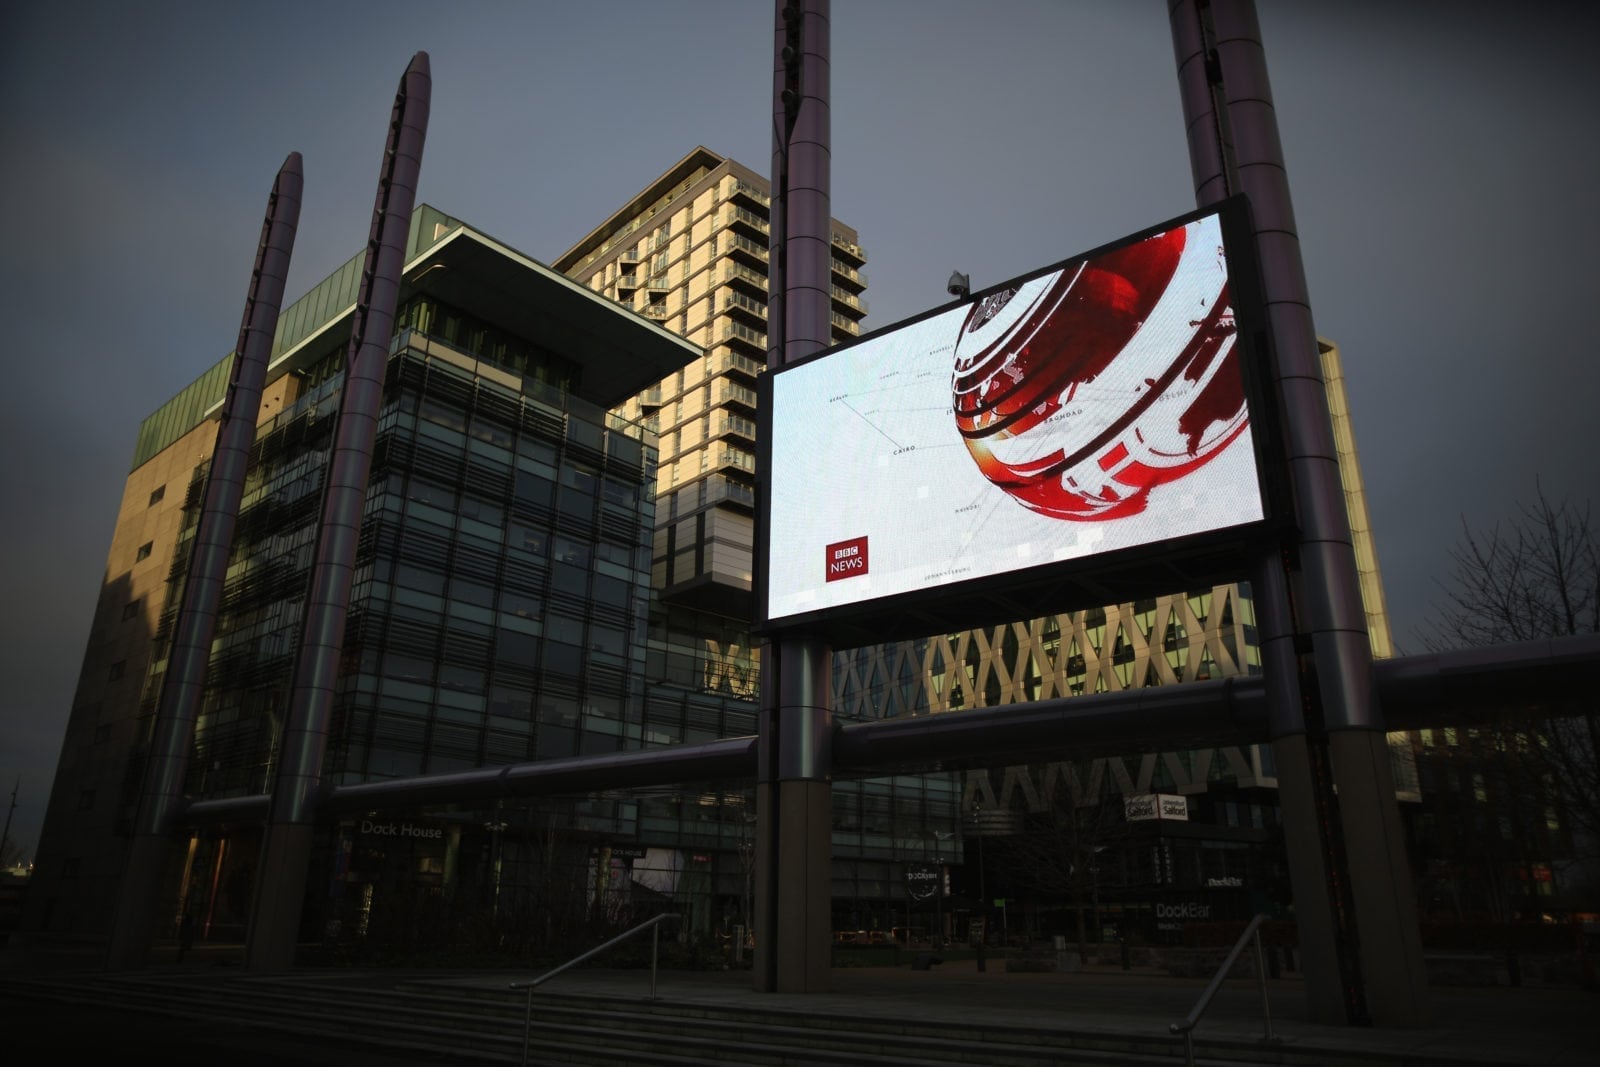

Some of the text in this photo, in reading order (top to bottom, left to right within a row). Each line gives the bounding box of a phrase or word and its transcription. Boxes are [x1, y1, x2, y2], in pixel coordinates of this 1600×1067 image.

[893, 445, 915, 455] CAIRO
[835, 546, 858, 559] BBC
[831, 557, 863, 574] NEWS
[1163, 805, 1186, 817] Salford
[361, 820, 442, 839] Dock House
